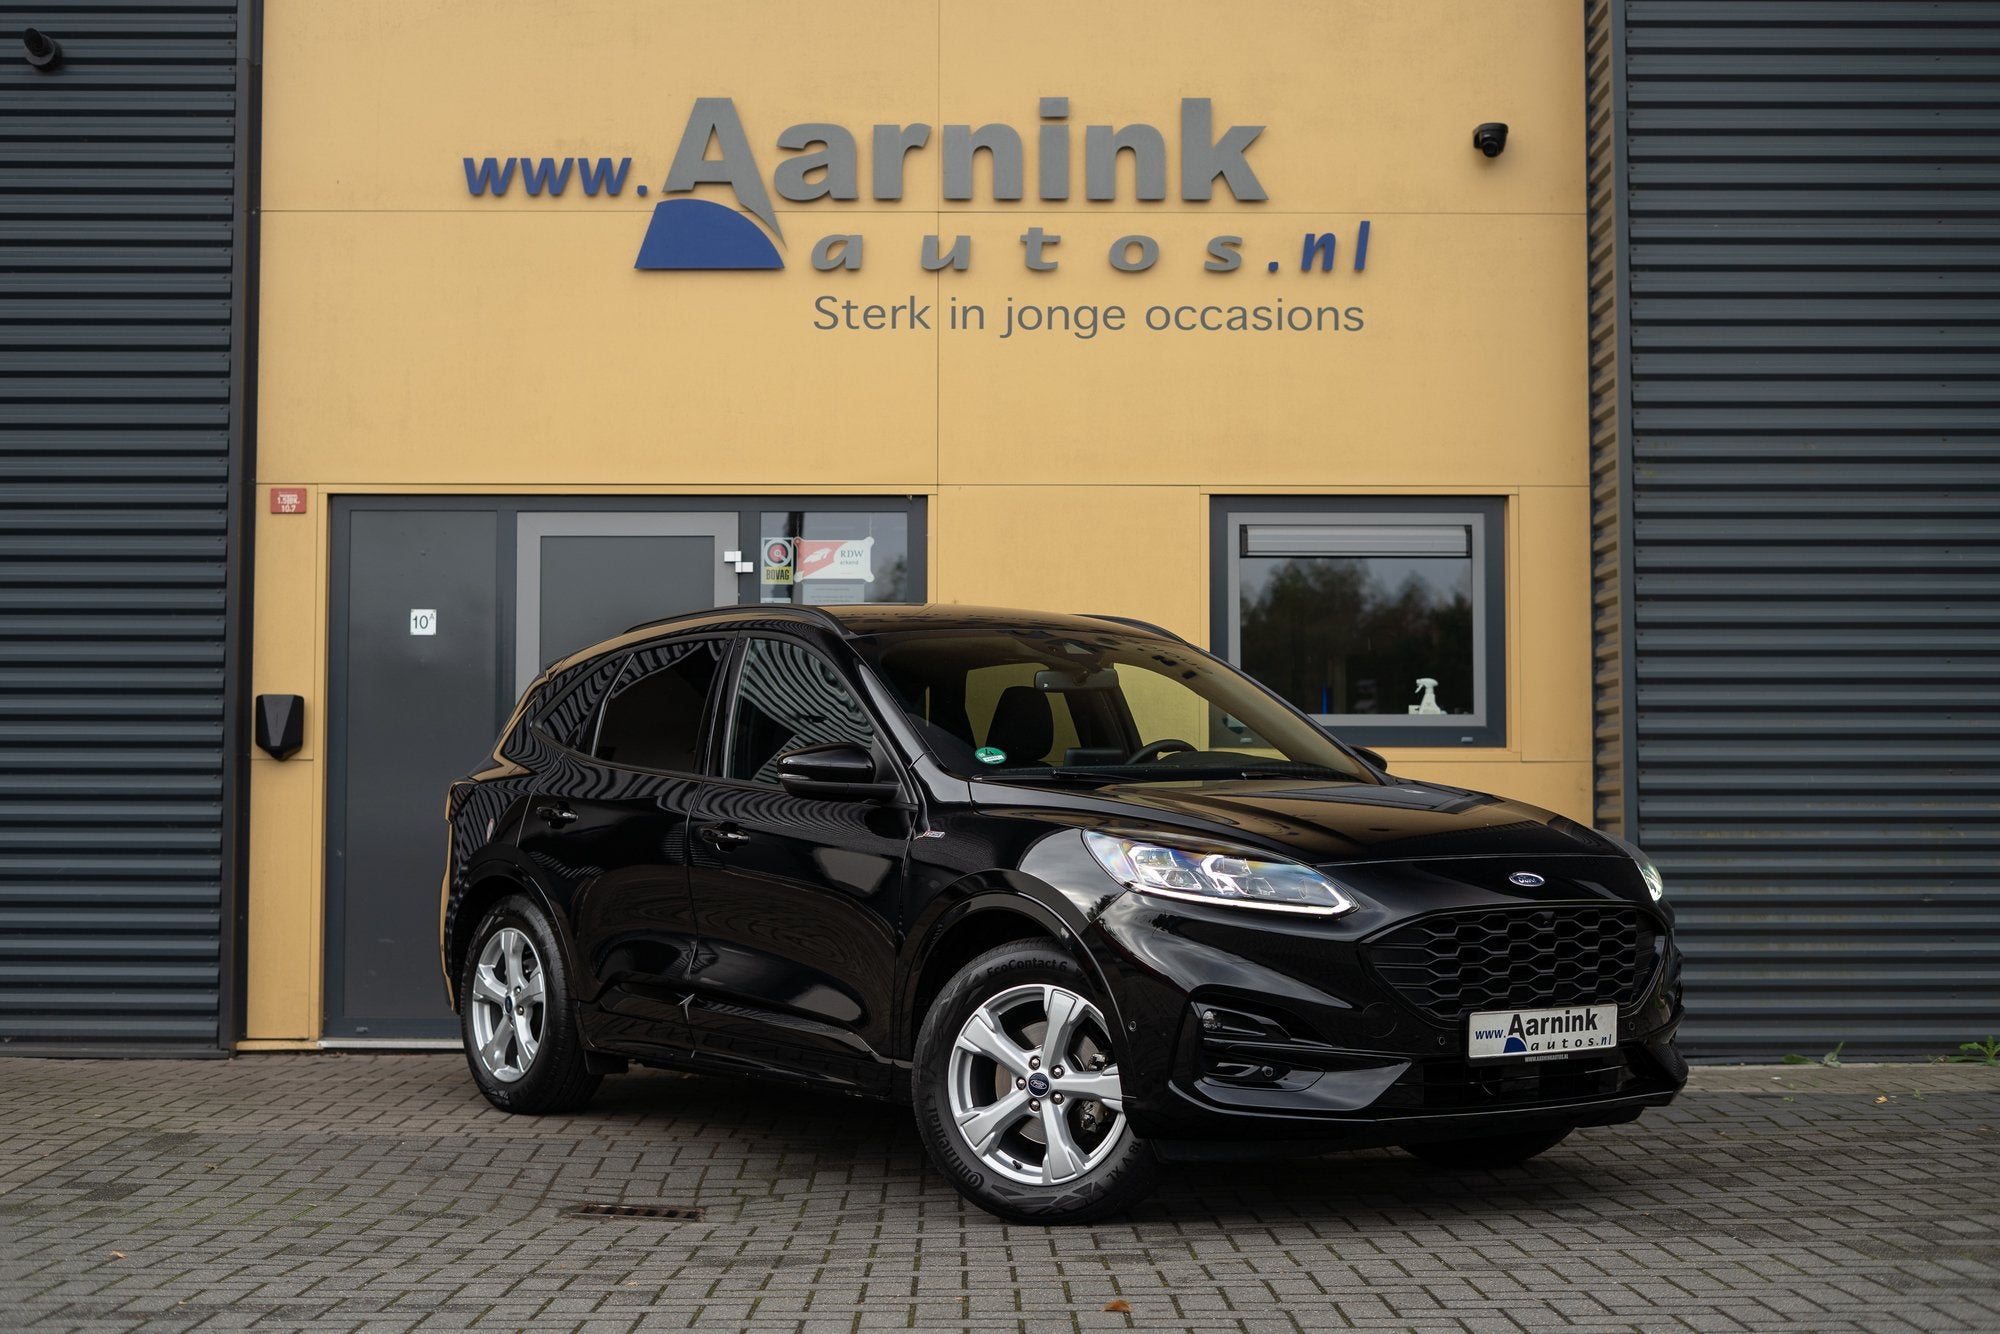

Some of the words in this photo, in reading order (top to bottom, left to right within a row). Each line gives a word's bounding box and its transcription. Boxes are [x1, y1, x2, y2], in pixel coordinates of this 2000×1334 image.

[813, 295, 932, 331] Sterk
[950, 297, 986, 330] in
[1000, 297, 1126, 339] jonge
[1145, 297, 1365, 331] occasions
[840, 550, 864, 558] RDW
[766, 569, 790, 581] BOVAG
[987, 957, 1057, 977] EcoContact
[1059, 961, 1068, 972] 6
